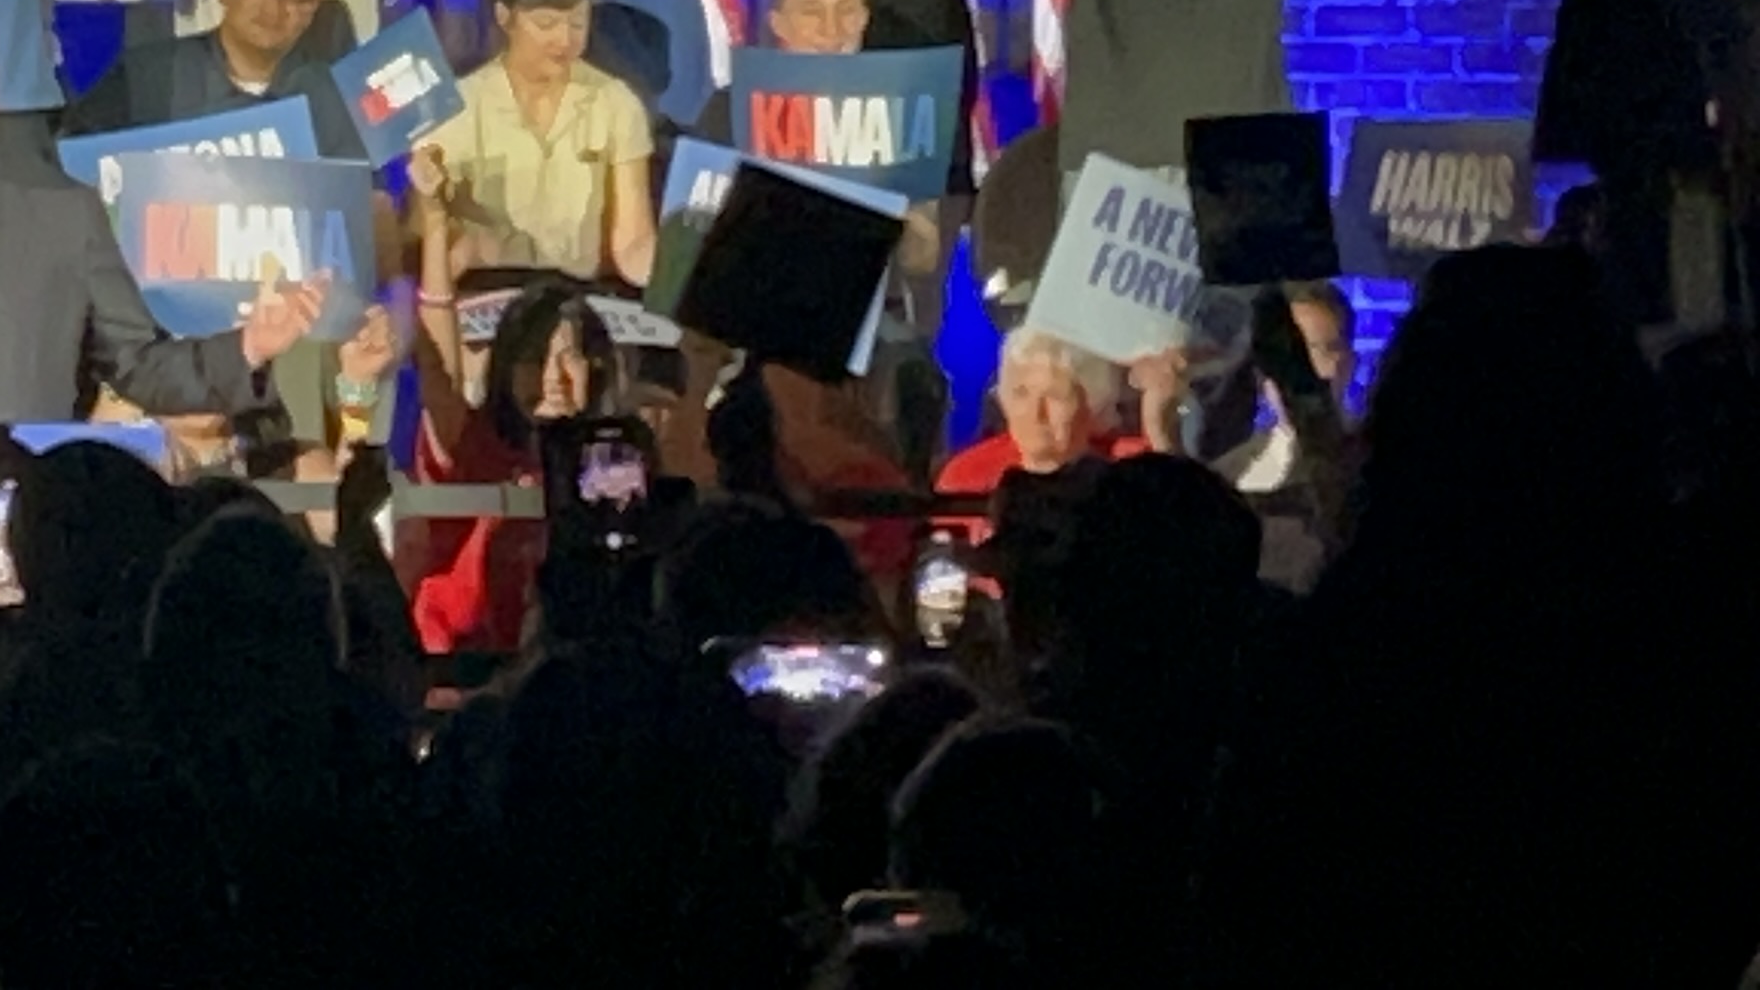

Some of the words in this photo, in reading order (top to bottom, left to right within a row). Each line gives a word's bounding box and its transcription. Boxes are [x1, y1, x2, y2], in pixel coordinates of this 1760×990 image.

[751, 91, 936, 166] KAMALA
[1092, 185, 1126, 233] A
[1370, 149, 1515, 221] HARRIS
